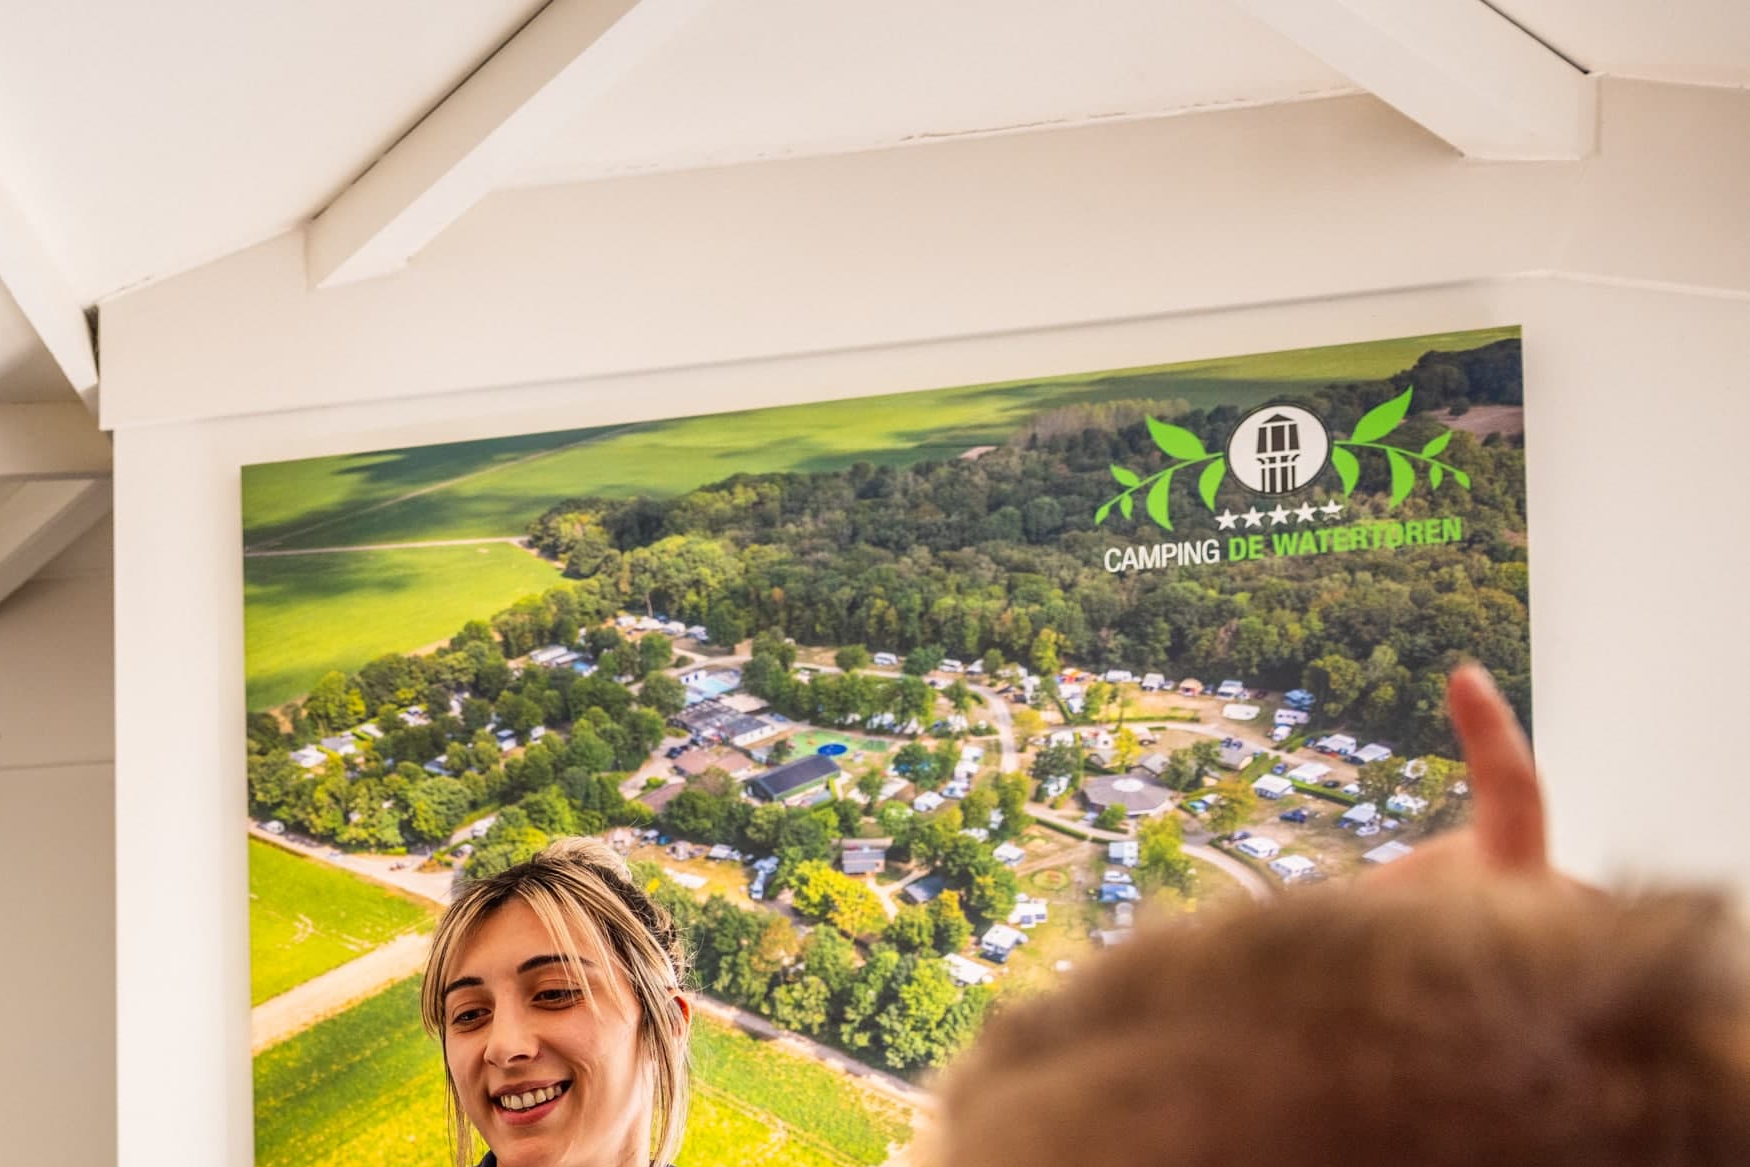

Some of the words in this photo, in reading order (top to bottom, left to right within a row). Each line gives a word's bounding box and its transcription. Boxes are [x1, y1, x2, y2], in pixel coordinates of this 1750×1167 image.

[1104, 539, 1220, 573] CAMPING
[1228, 535, 1265, 562] DE
[1273, 517, 1462, 557] WATERTOREN
